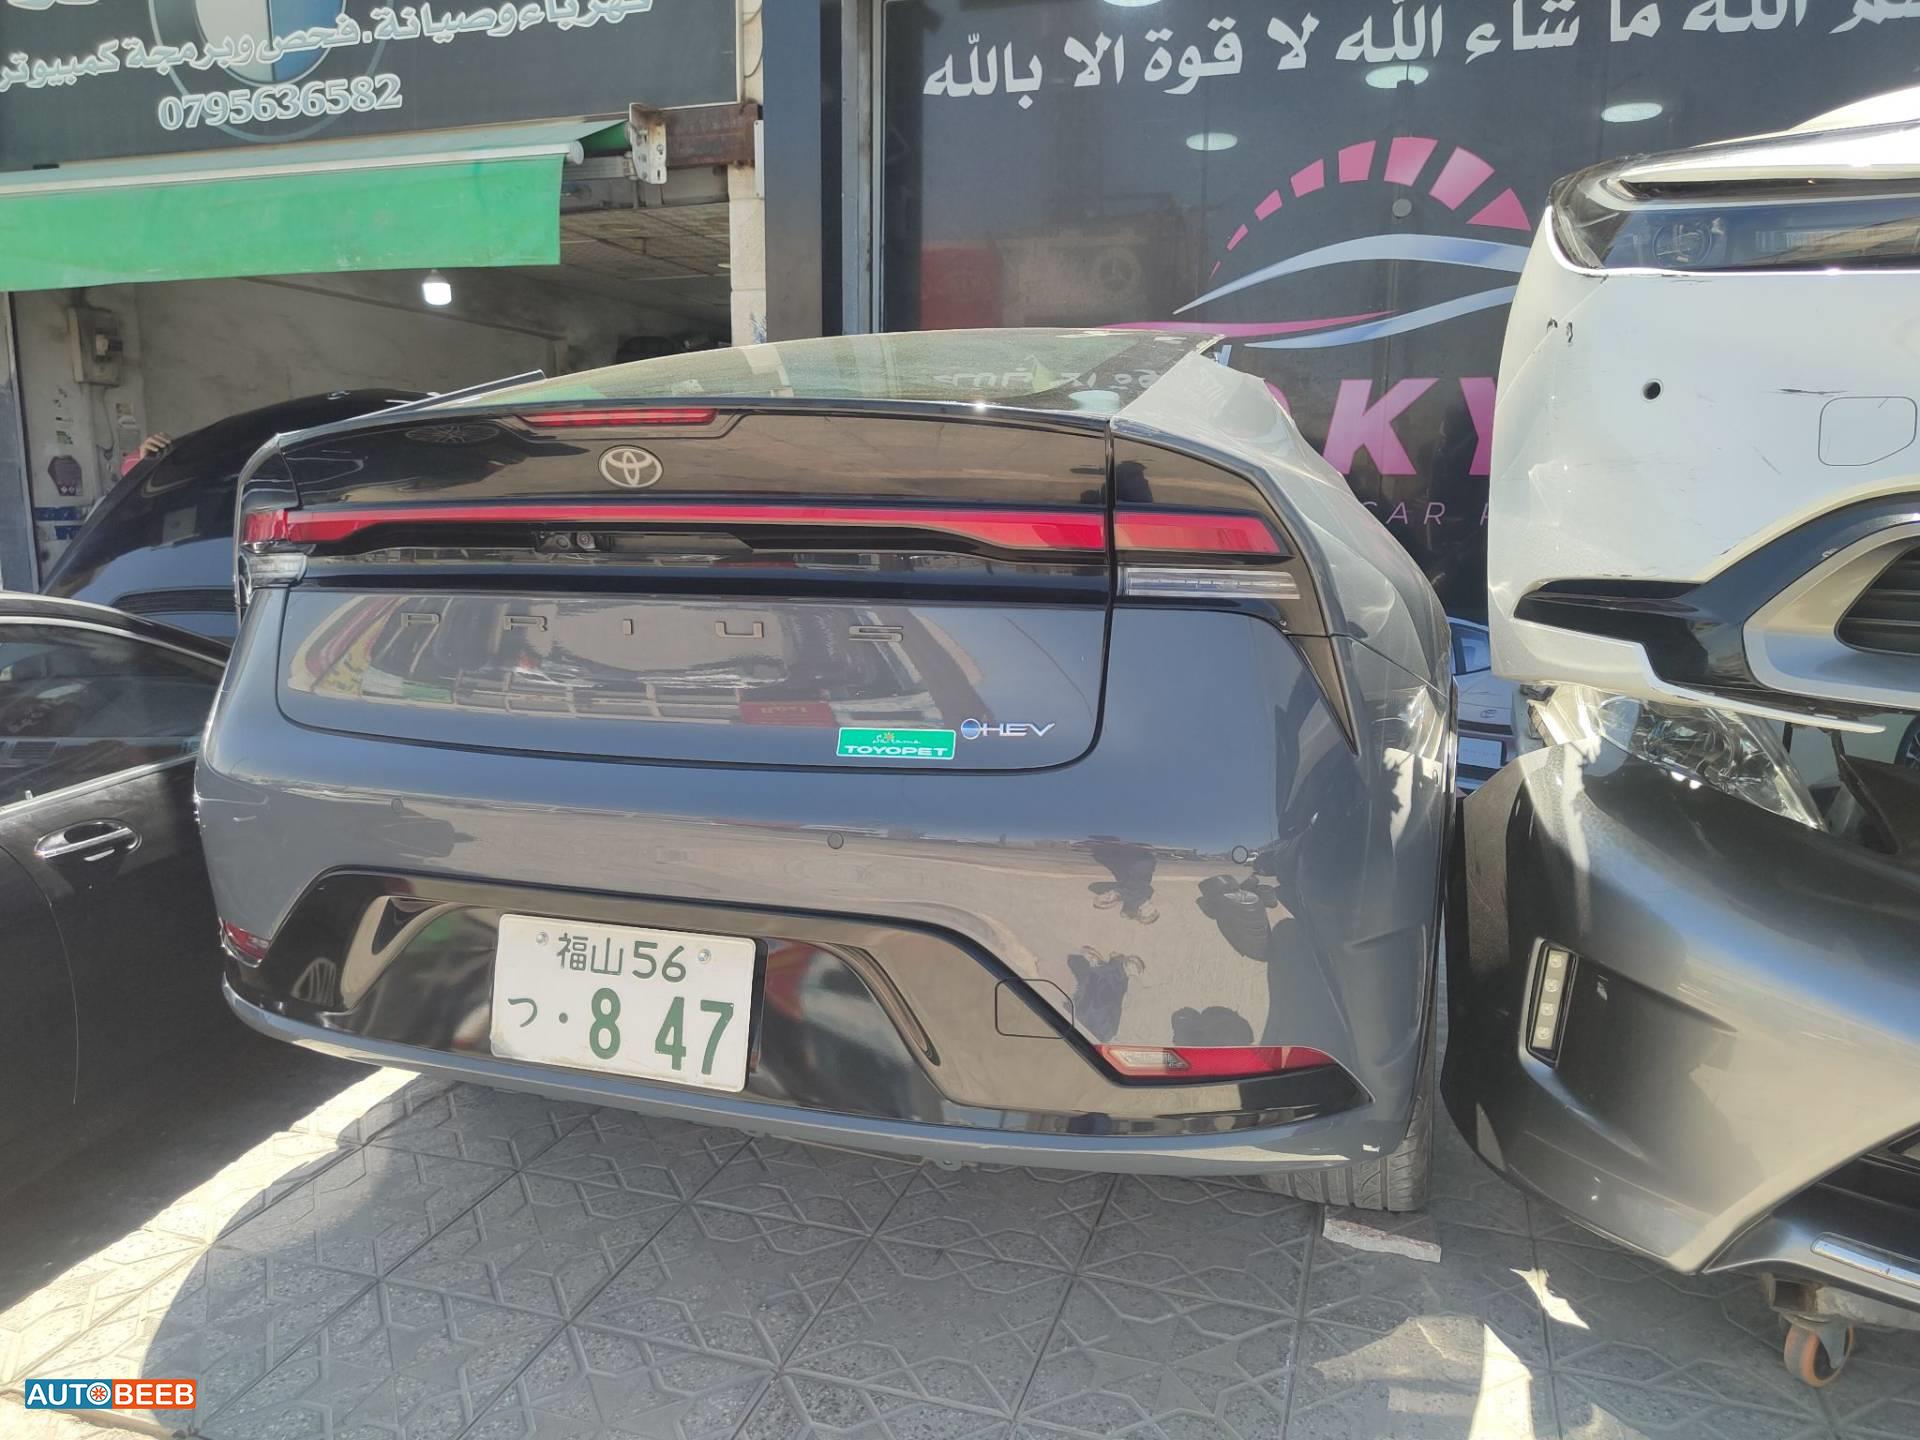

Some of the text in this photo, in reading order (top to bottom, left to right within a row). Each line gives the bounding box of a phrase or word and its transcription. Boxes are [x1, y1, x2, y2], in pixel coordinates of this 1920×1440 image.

[1144, 16, 1243, 95] قوة
[1267, 11, 1320, 70] لا
[1335, 0, 1443, 63] الله
[157, 73, 403, 131] 0795636582
[844, 745, 949, 757] TOYOPET
